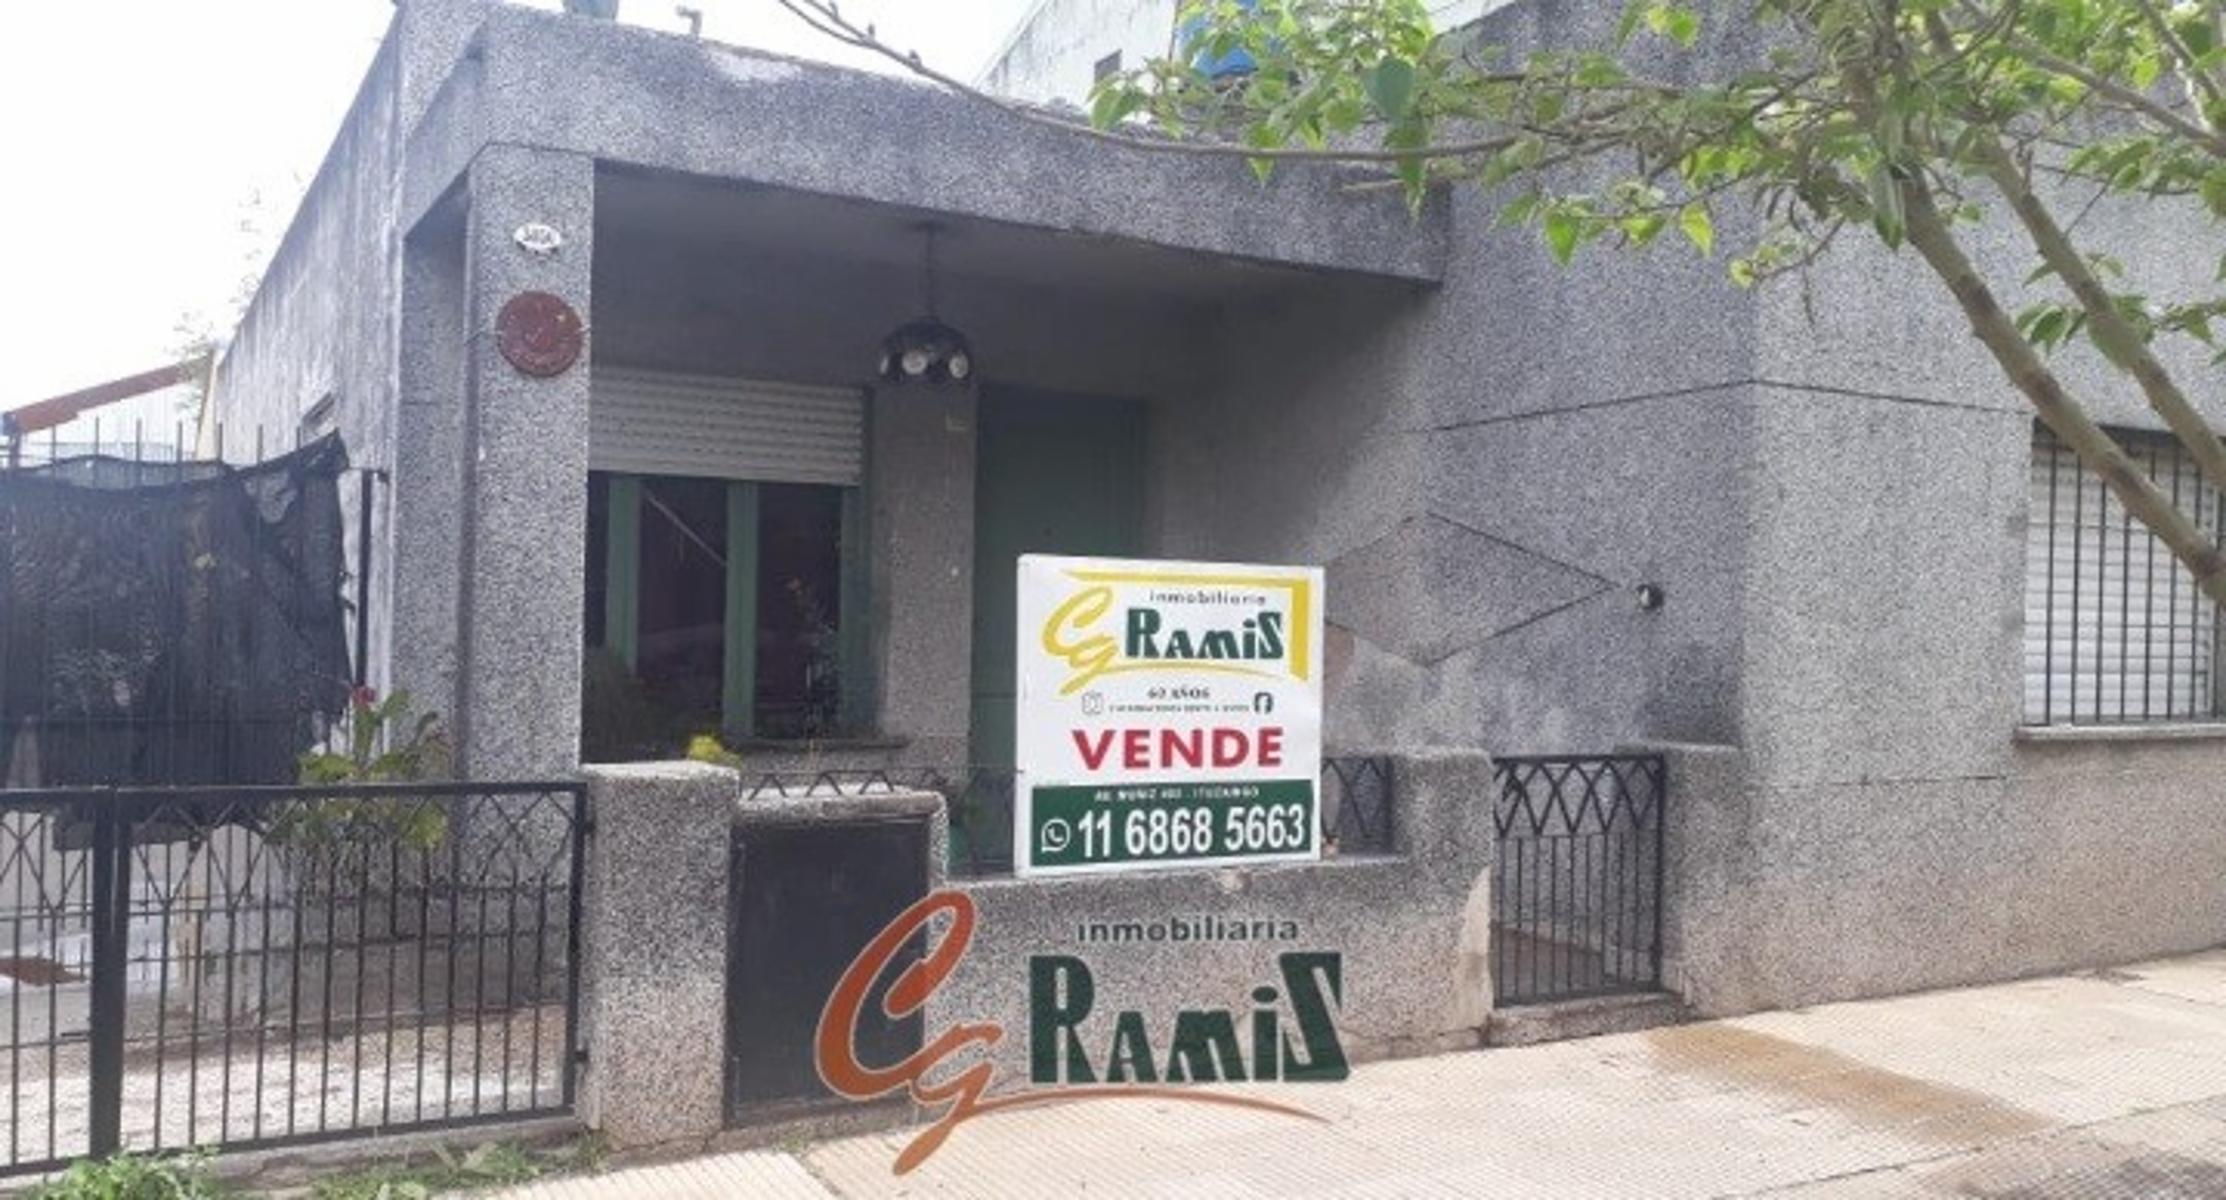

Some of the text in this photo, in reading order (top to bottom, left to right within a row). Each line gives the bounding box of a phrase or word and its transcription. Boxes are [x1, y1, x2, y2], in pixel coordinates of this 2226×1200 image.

[1149, 589, 1267, 606] inmobiliaria
[1071, 726, 1284, 771] VENDE
[1078, 803, 1305, 858] 11 6868 5663
